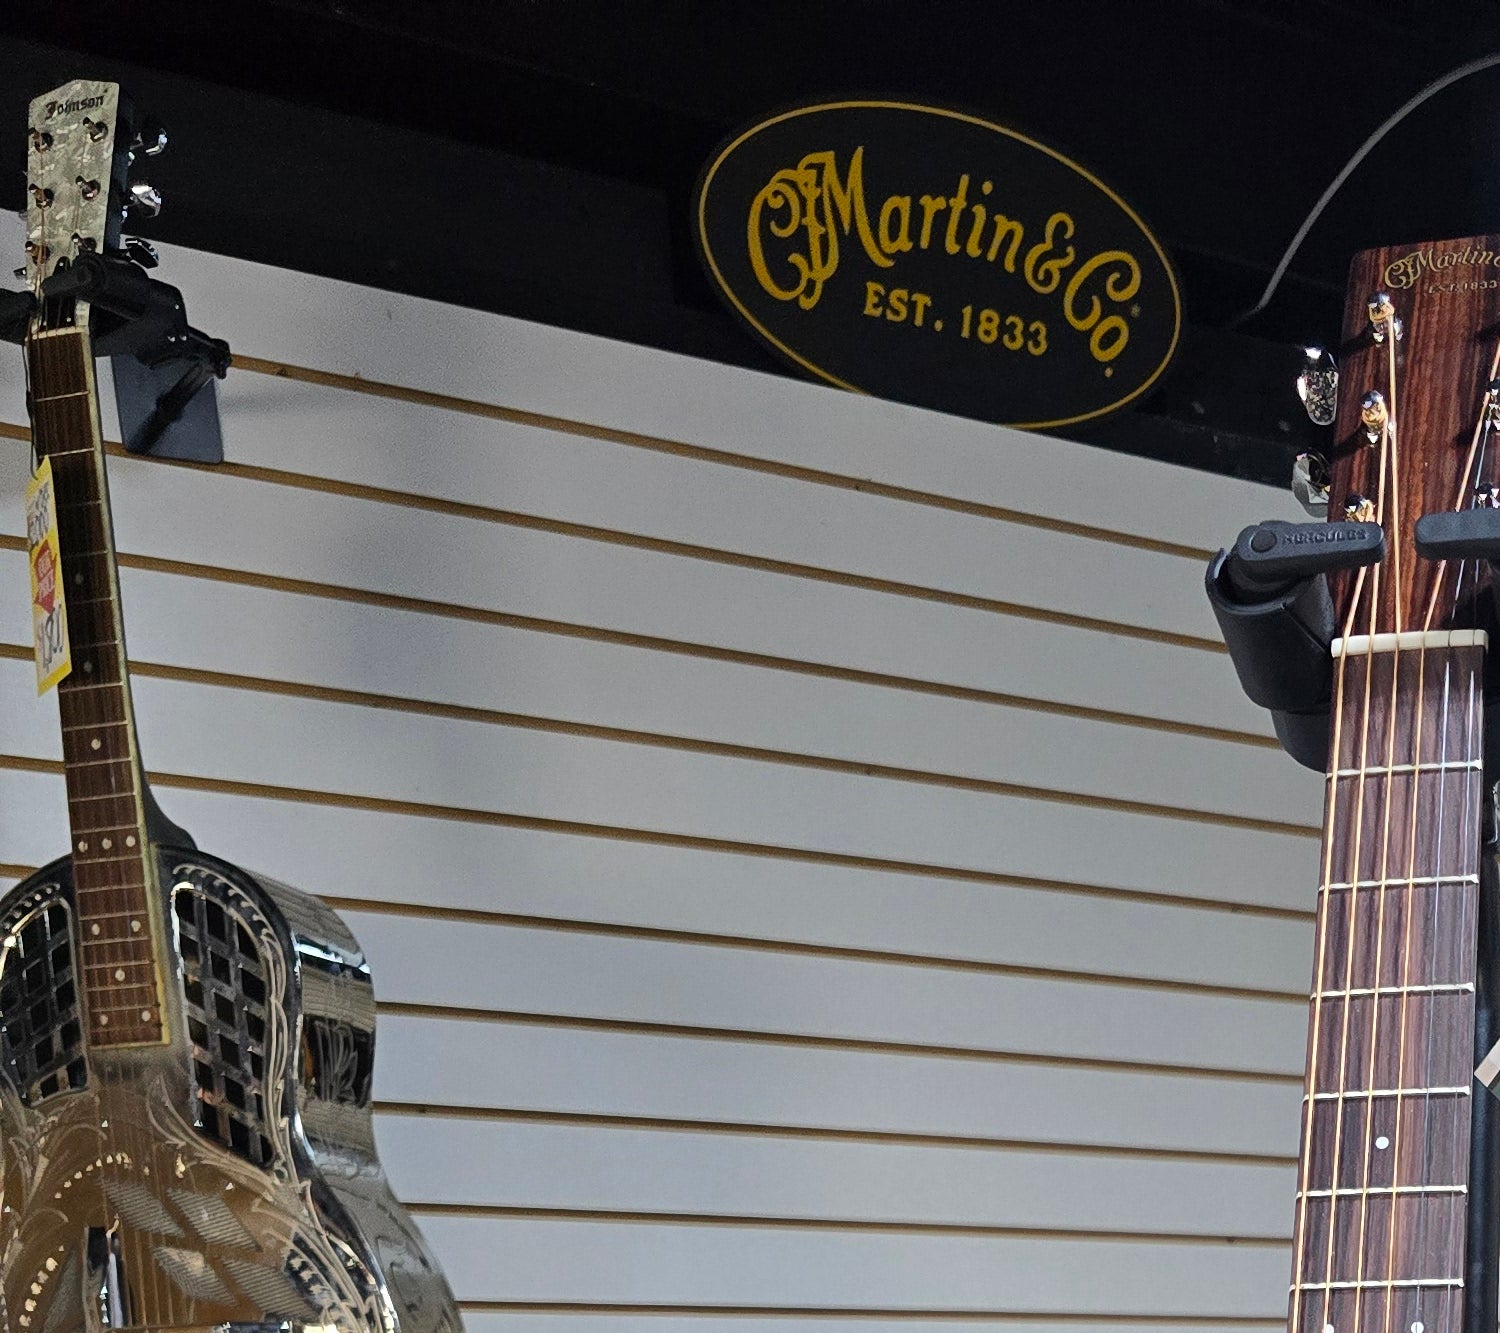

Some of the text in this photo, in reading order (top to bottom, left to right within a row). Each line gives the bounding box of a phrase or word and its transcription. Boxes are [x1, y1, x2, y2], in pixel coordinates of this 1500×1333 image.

[45, 96, 104, 120] Johnson
[1464, 279, 1498, 291] 1833
[863, 281, 1048, 357] EST. 1833
